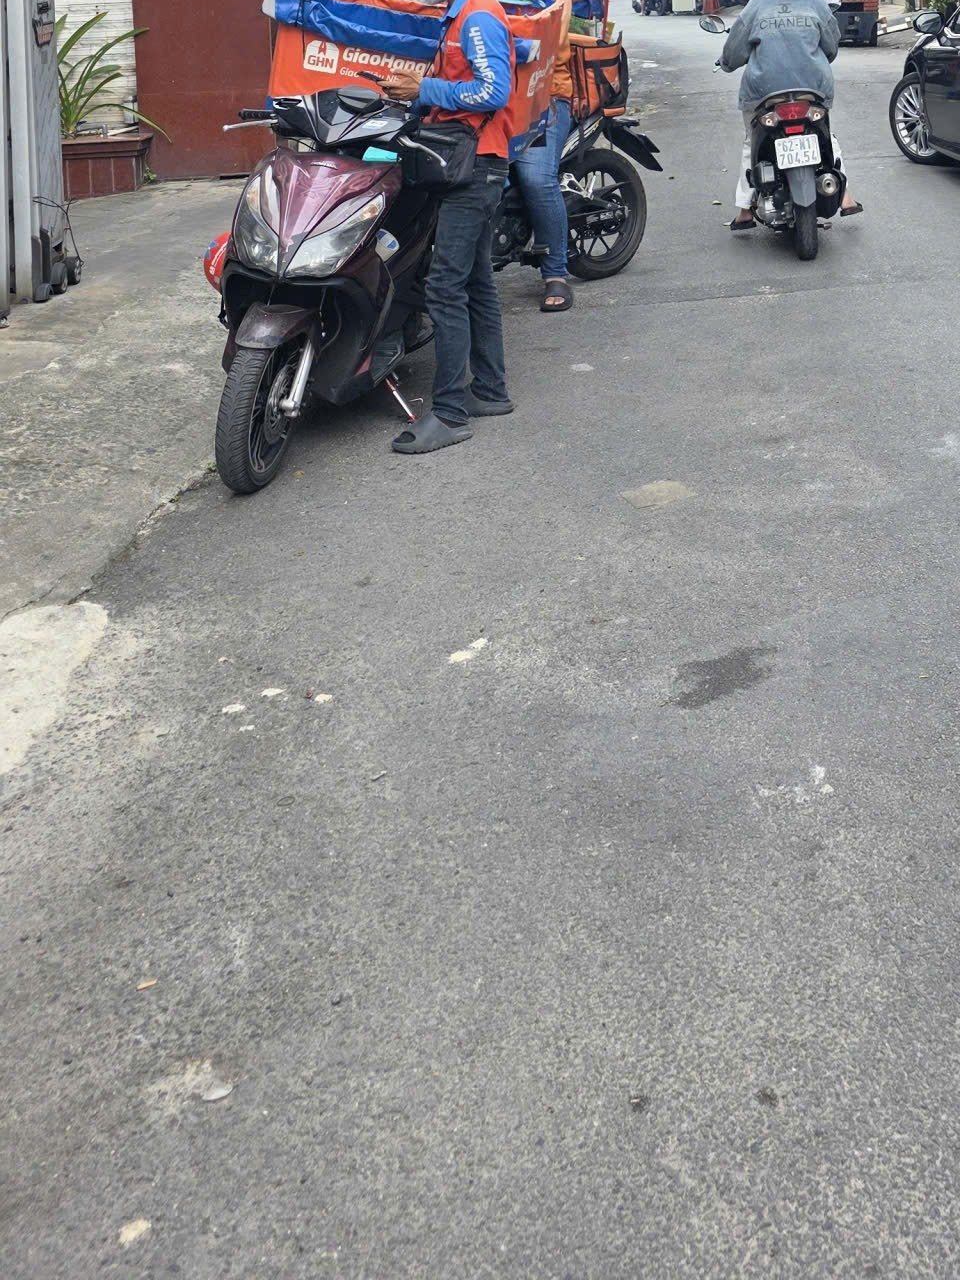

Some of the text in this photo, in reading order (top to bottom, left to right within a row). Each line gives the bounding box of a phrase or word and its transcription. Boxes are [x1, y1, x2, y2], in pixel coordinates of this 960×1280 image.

[759, 17, 812, 30] CHANEL
[307, 54, 335, 69] GHN
[780, 150, 818, 166] 704.54
